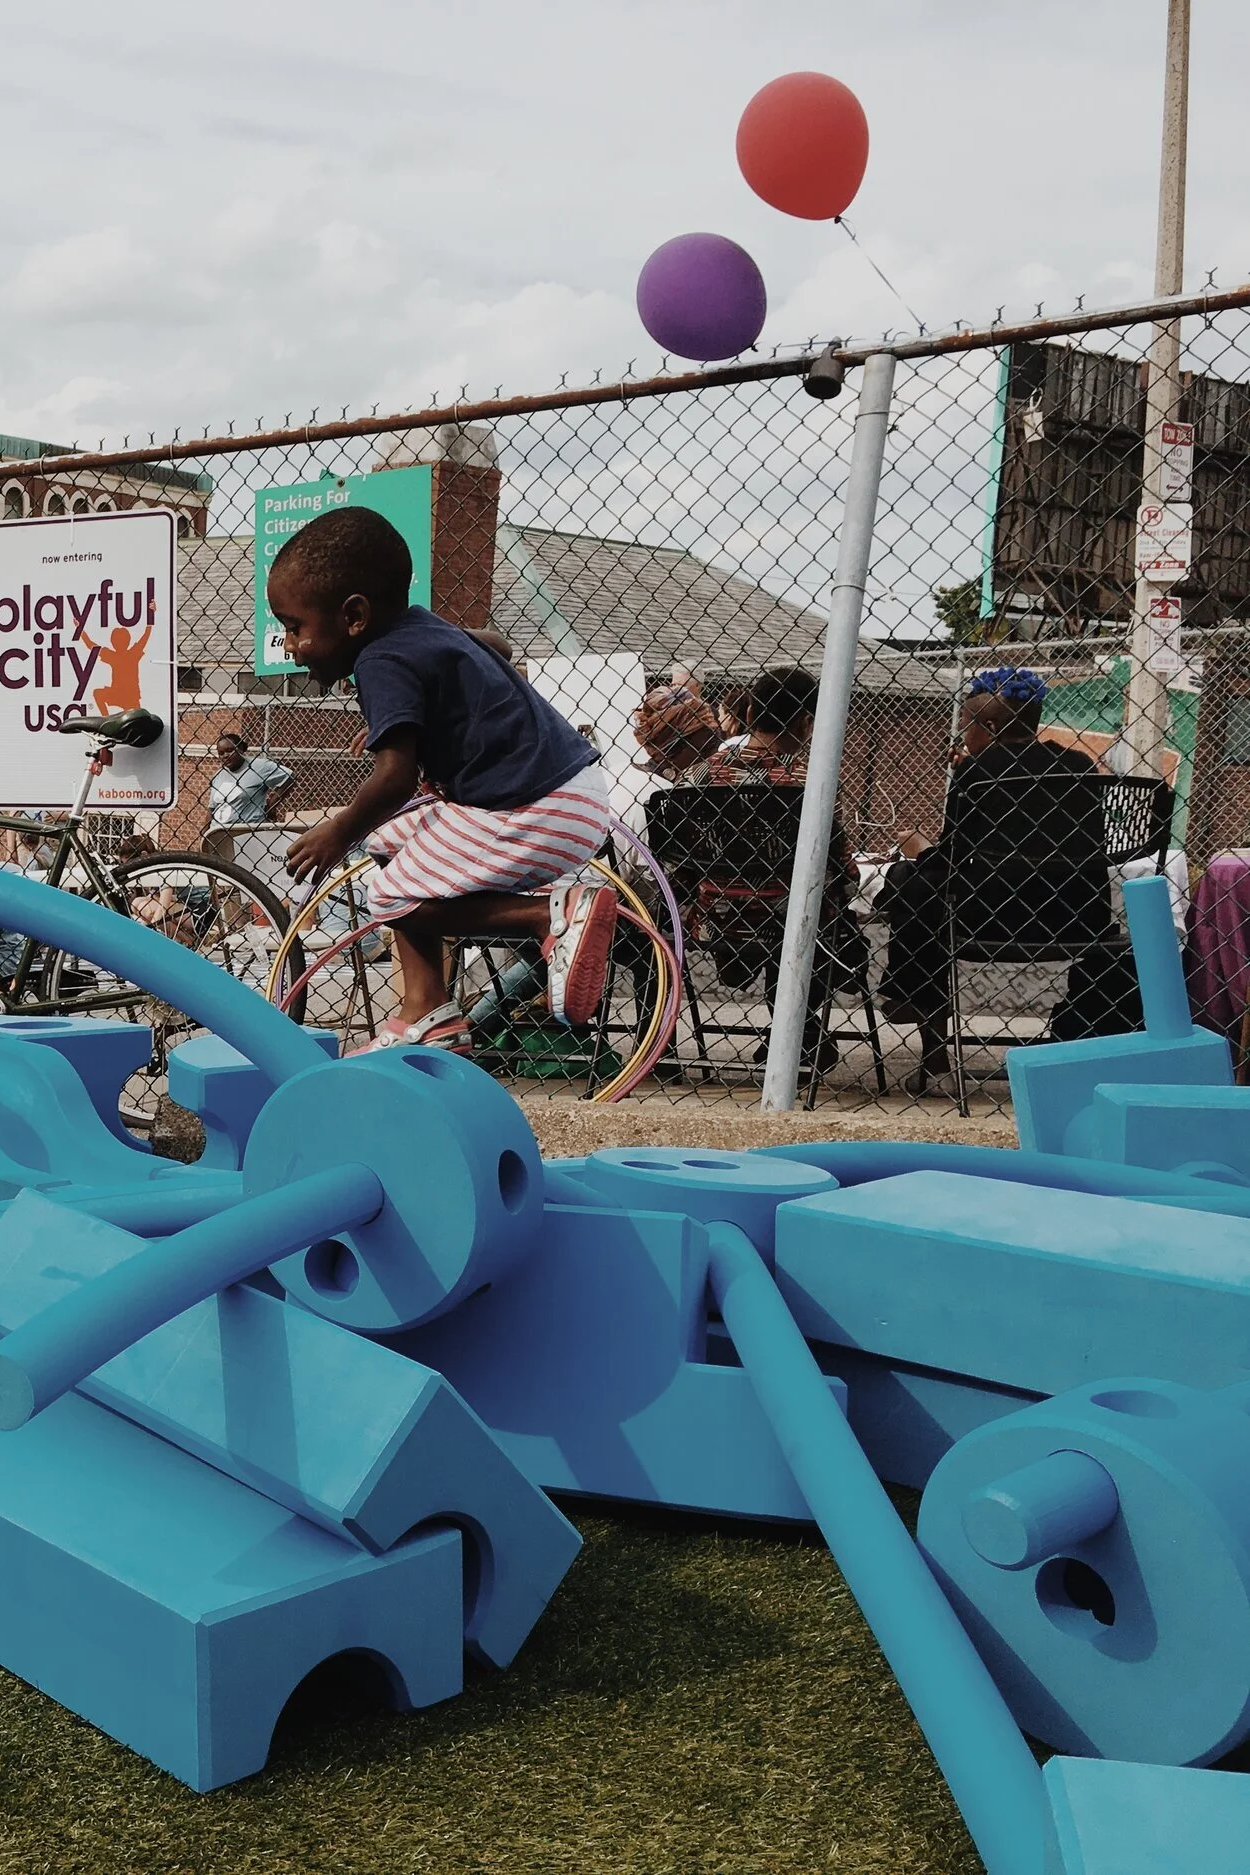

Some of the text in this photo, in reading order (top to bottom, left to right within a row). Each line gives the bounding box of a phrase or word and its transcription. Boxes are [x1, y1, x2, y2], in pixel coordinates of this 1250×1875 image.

[1171, 448, 1183, 458] NO
[264, 490, 351, 513] Parking For
[42, 551, 103, 564] now entering
[98, 788, 166, 801] kaboom.org
